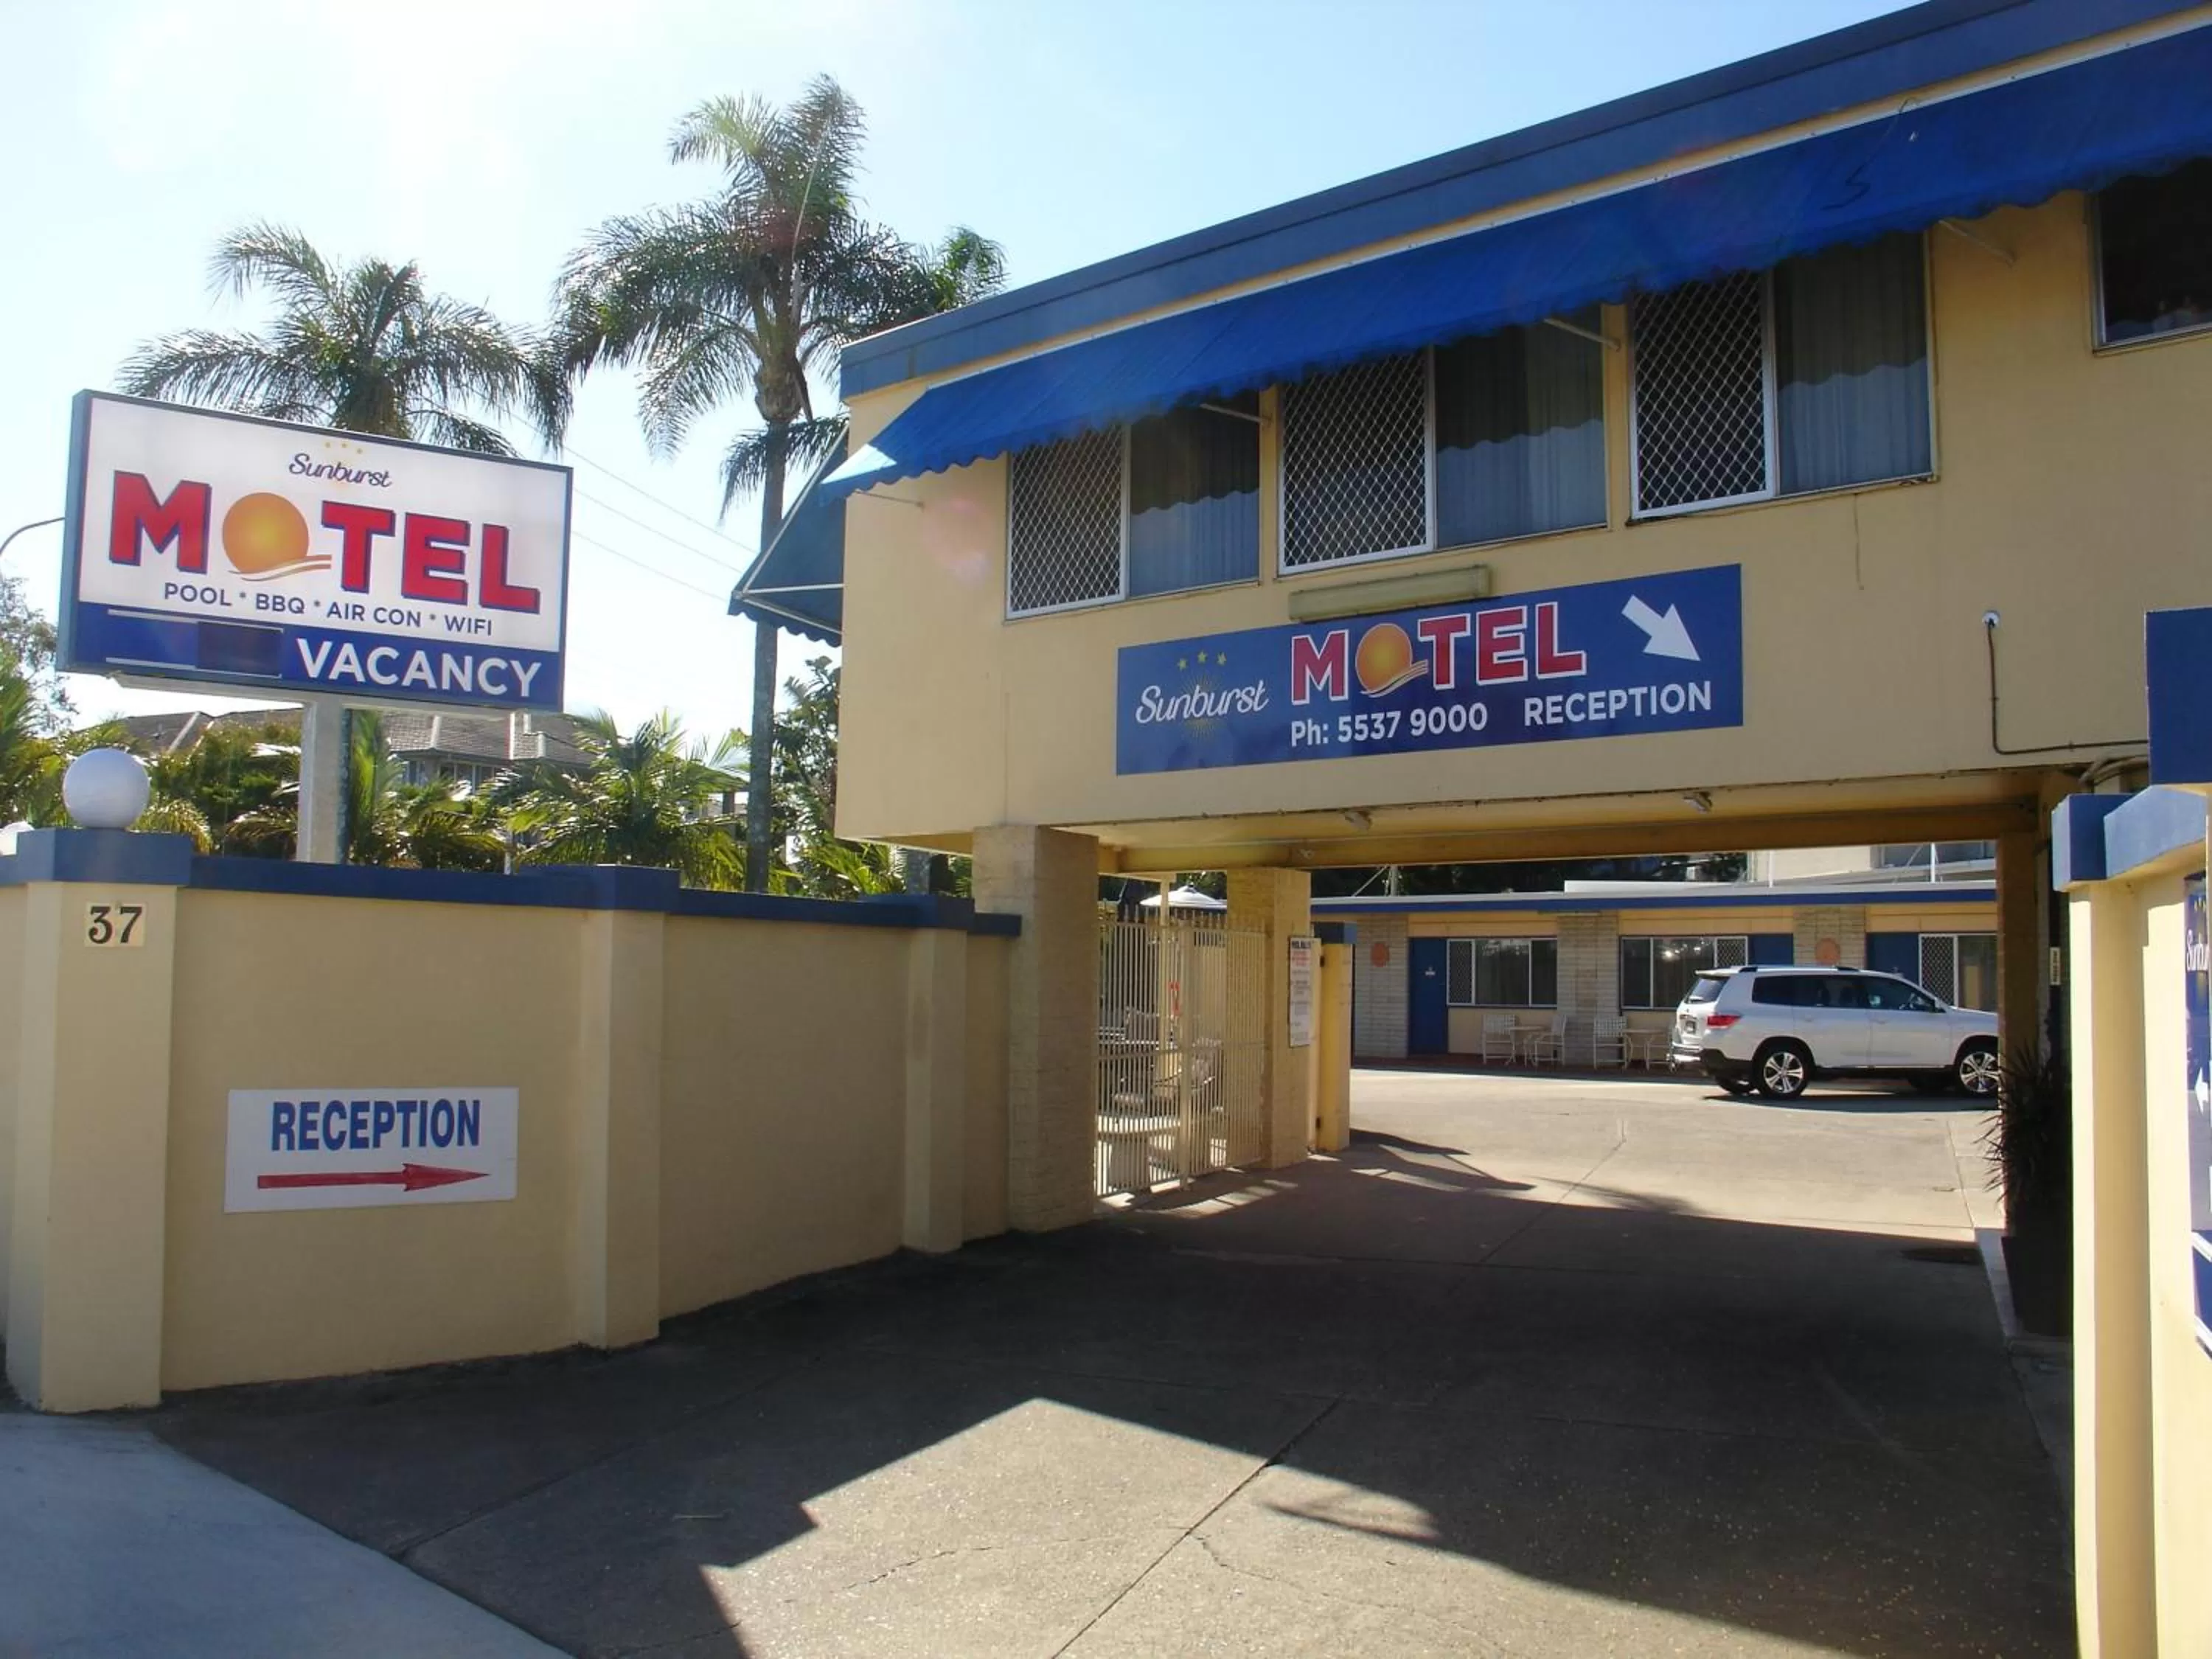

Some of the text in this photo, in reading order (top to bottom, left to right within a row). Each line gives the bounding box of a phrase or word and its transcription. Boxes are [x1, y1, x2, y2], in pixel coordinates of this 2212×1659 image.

[288, 453, 392, 487] Sunburst
[109, 470, 540, 614] MOTEL
[164, 582, 493, 636] POOL BBQ AIR CON WIFI
[296, 636, 542, 698] VACANCY
[1290, 600, 1587, 706] MOTEL
[1135, 679, 1270, 724] Sunburst
[1291, 680, 1712, 747] Ph: 5537 9000 RECEPTION
[87, 905, 143, 945] 37
[271, 1099, 481, 1152] RECEPTION
